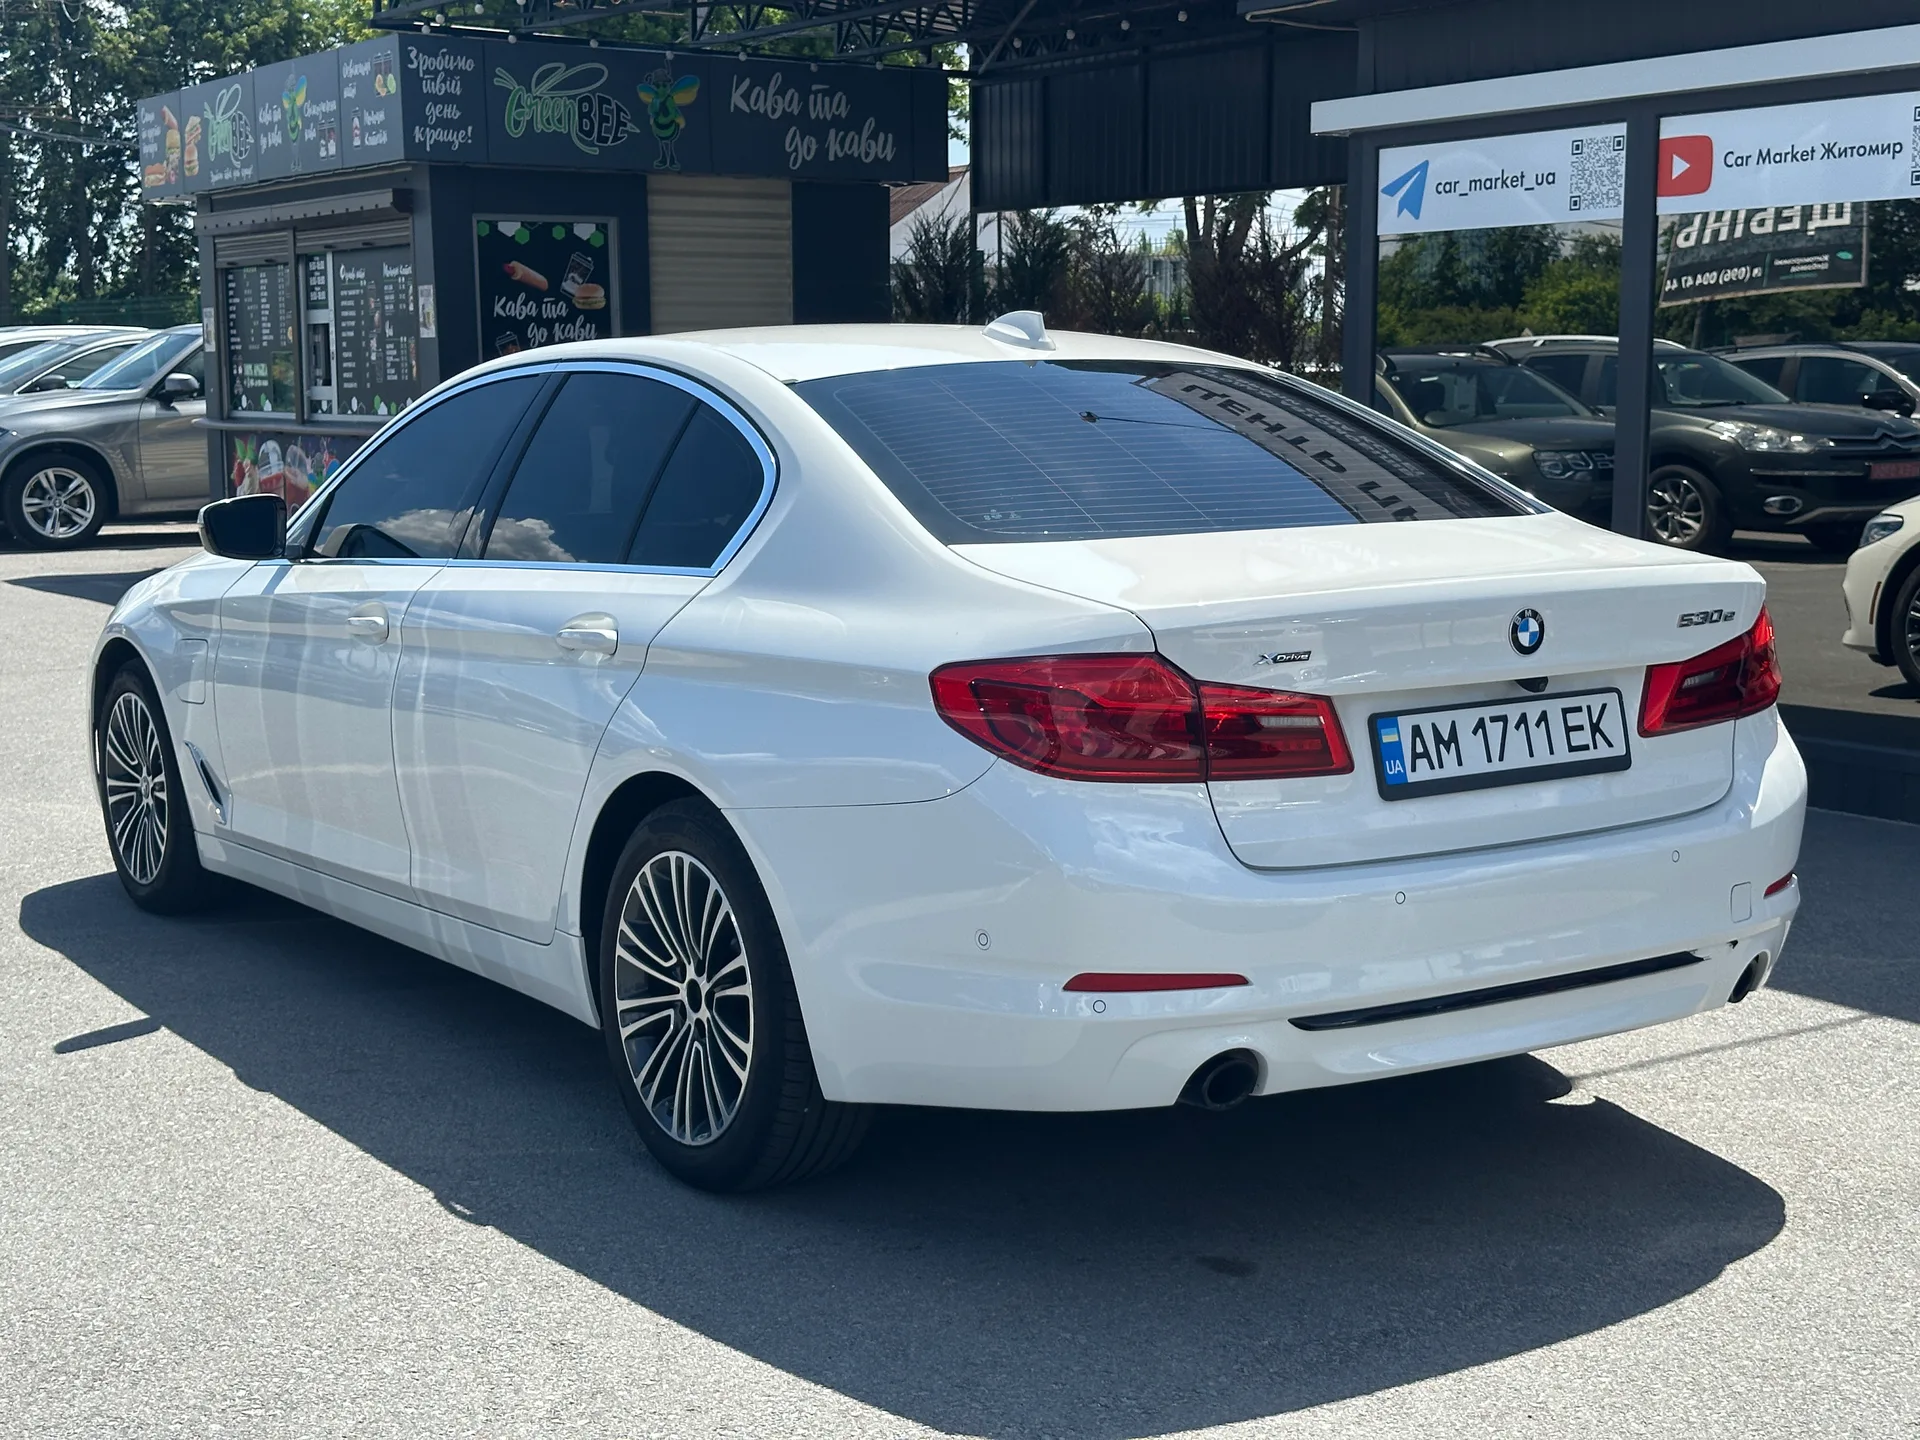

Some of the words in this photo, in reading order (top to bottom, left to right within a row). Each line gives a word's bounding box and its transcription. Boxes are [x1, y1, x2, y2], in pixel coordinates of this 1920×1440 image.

[407, 46, 475, 77] Зробимо
[422, 72, 462, 96] твій
[730, 72, 803, 119] Кава
[808, 84, 851, 121] та
[425, 101, 461, 125] день
[413, 125, 473, 152] краще!
[785, 126, 819, 170] до
[825, 117, 896, 163] кави
[1724, 151, 1752, 168] Car
[1756, 144, 1816, 165] Market
[1820, 141, 1904, 160] Житомир
[1435, 168, 1556, 197] car_market_ua
[493, 292, 539, 320] Кава
[541, 297, 569, 319] та
[527, 322, 549, 348] до
[552, 314, 598, 340] кави
[1677, 609, 1736, 628] 530e
[1386, 760, 1404, 775] UA
[1411, 720, 1463, 773] AM
[1471, 710, 1555, 763] 1711
[1561, 702, 1614, 753] EK
